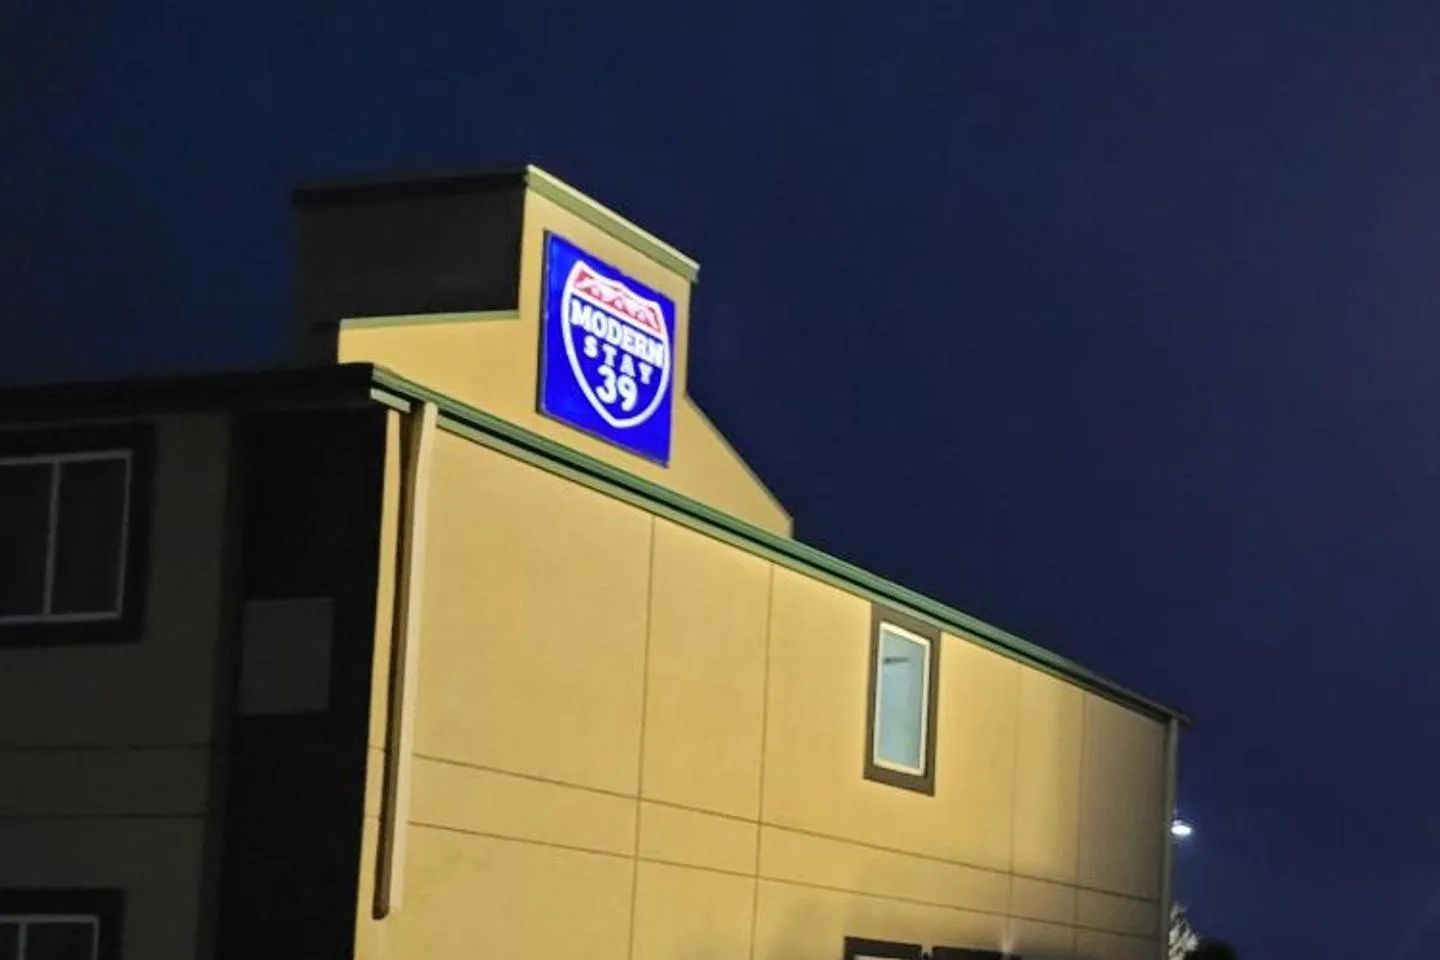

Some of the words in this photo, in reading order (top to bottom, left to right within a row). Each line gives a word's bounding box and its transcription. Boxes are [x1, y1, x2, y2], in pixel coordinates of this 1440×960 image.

[571, 299, 664, 368] MODERN
[584, 336, 653, 384] STAY
[596, 365, 638, 412] 39
